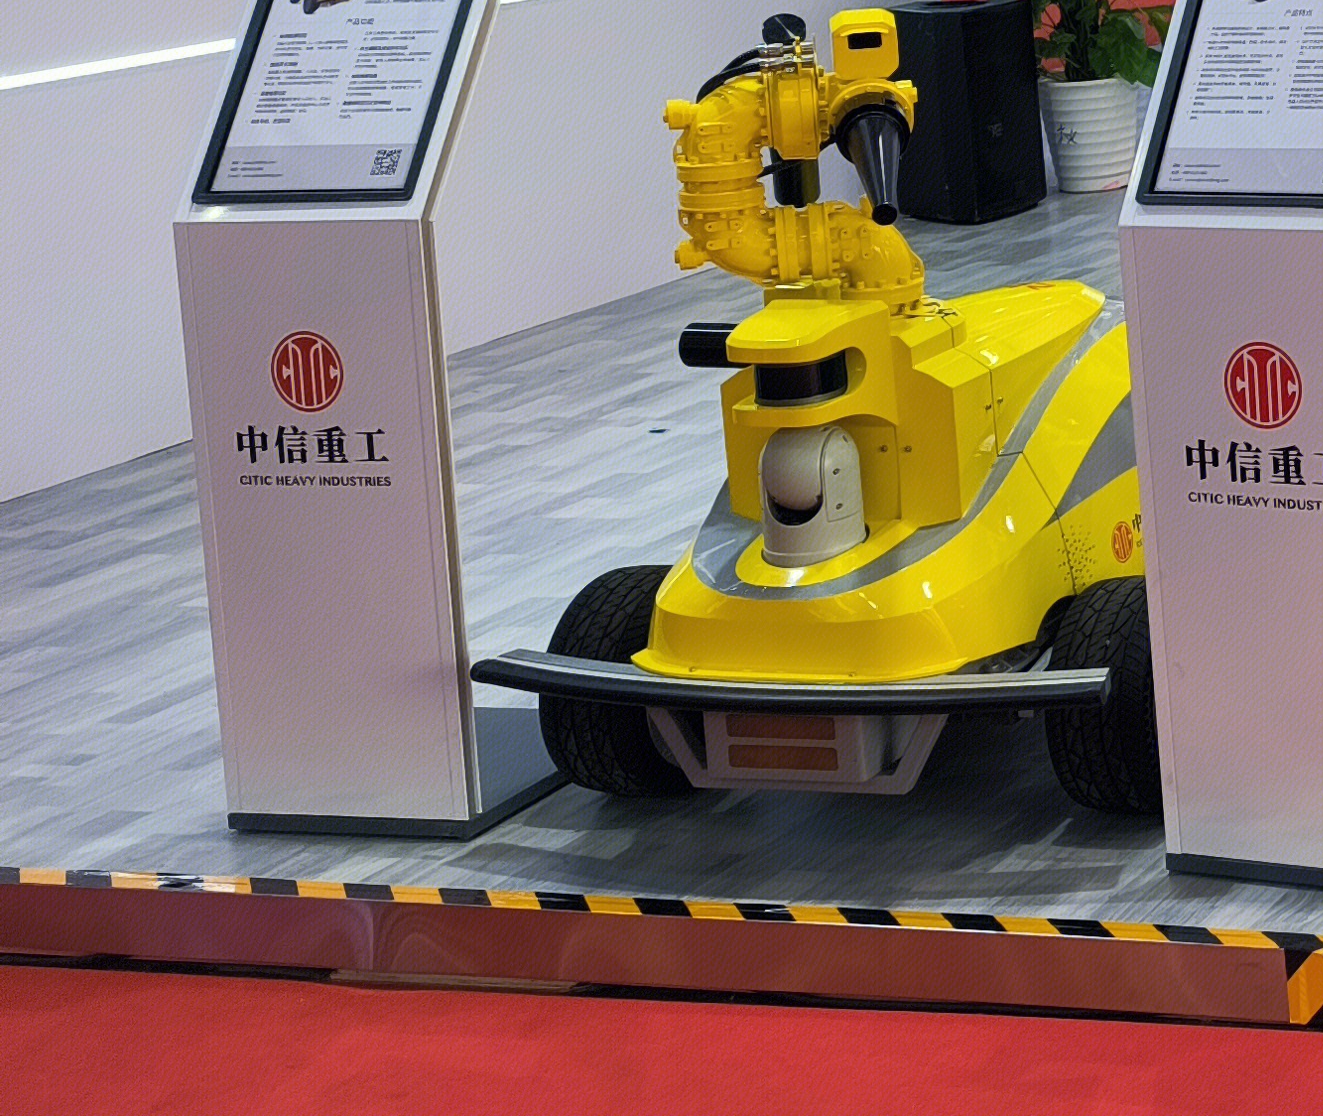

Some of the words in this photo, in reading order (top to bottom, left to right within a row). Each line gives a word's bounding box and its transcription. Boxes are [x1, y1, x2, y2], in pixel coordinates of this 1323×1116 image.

[236, 425, 390, 465] 中信重工
[239, 474, 272, 486] CITIC
[276, 475, 316, 486] HEAVY
[319, 474, 392, 487] INDUSTRIES
[1188, 491, 1224, 505] CITIC
[1227, 494, 1270, 509] HEAVY
